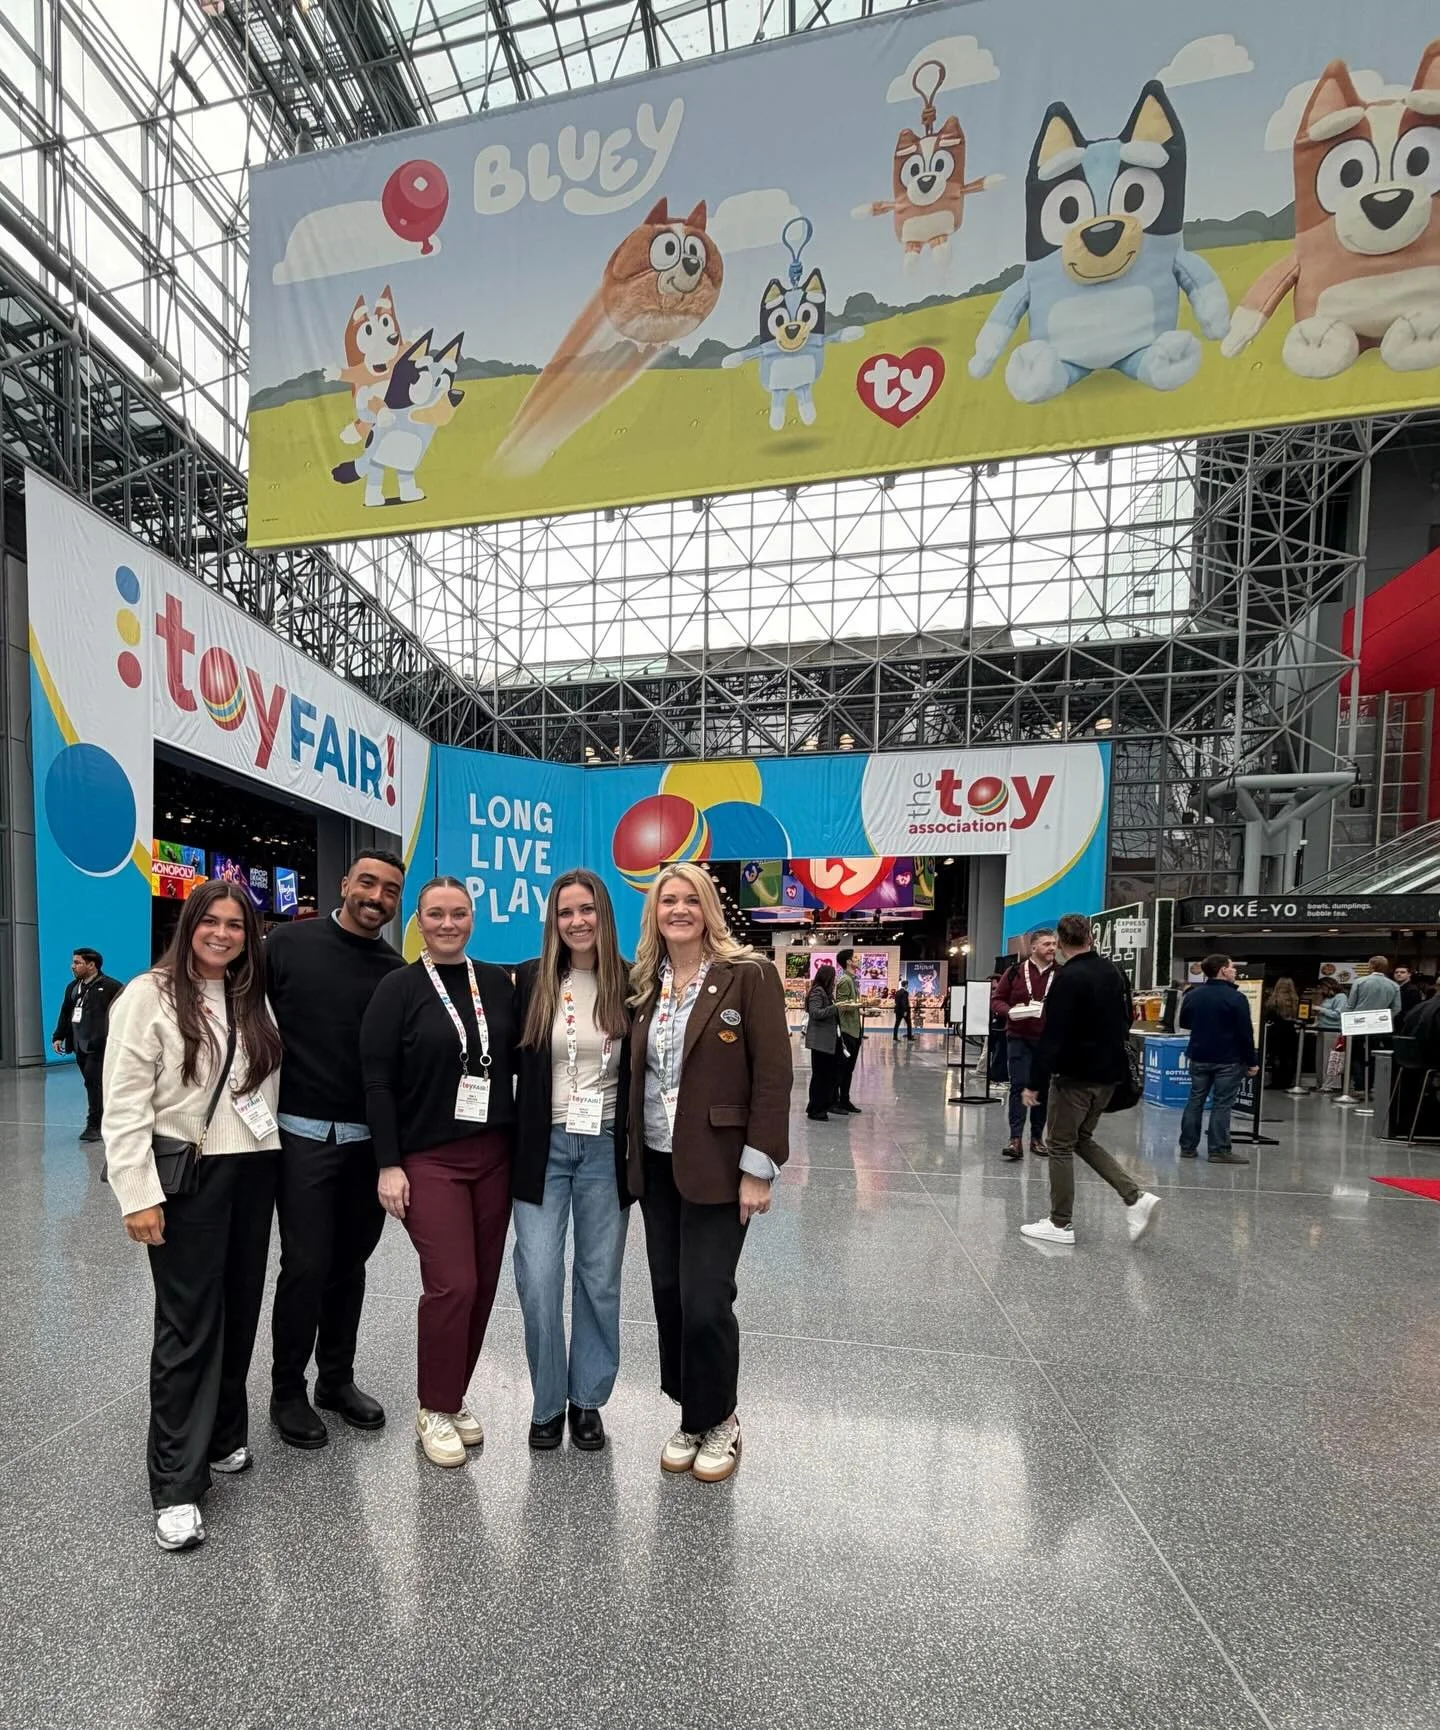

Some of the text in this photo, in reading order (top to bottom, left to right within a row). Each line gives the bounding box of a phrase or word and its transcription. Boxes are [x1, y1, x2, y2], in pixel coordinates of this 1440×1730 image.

[473, 98, 684, 215] BLUEY
[863, 358, 934, 412] ty
[469, 793, 553, 833] LONG
[906, 768, 1055, 829] the toy
[908, 819, 1007, 834] association
[471, 834, 551, 874] LIVE
[1204, 900, 1297, 917] POKÉ-YO
